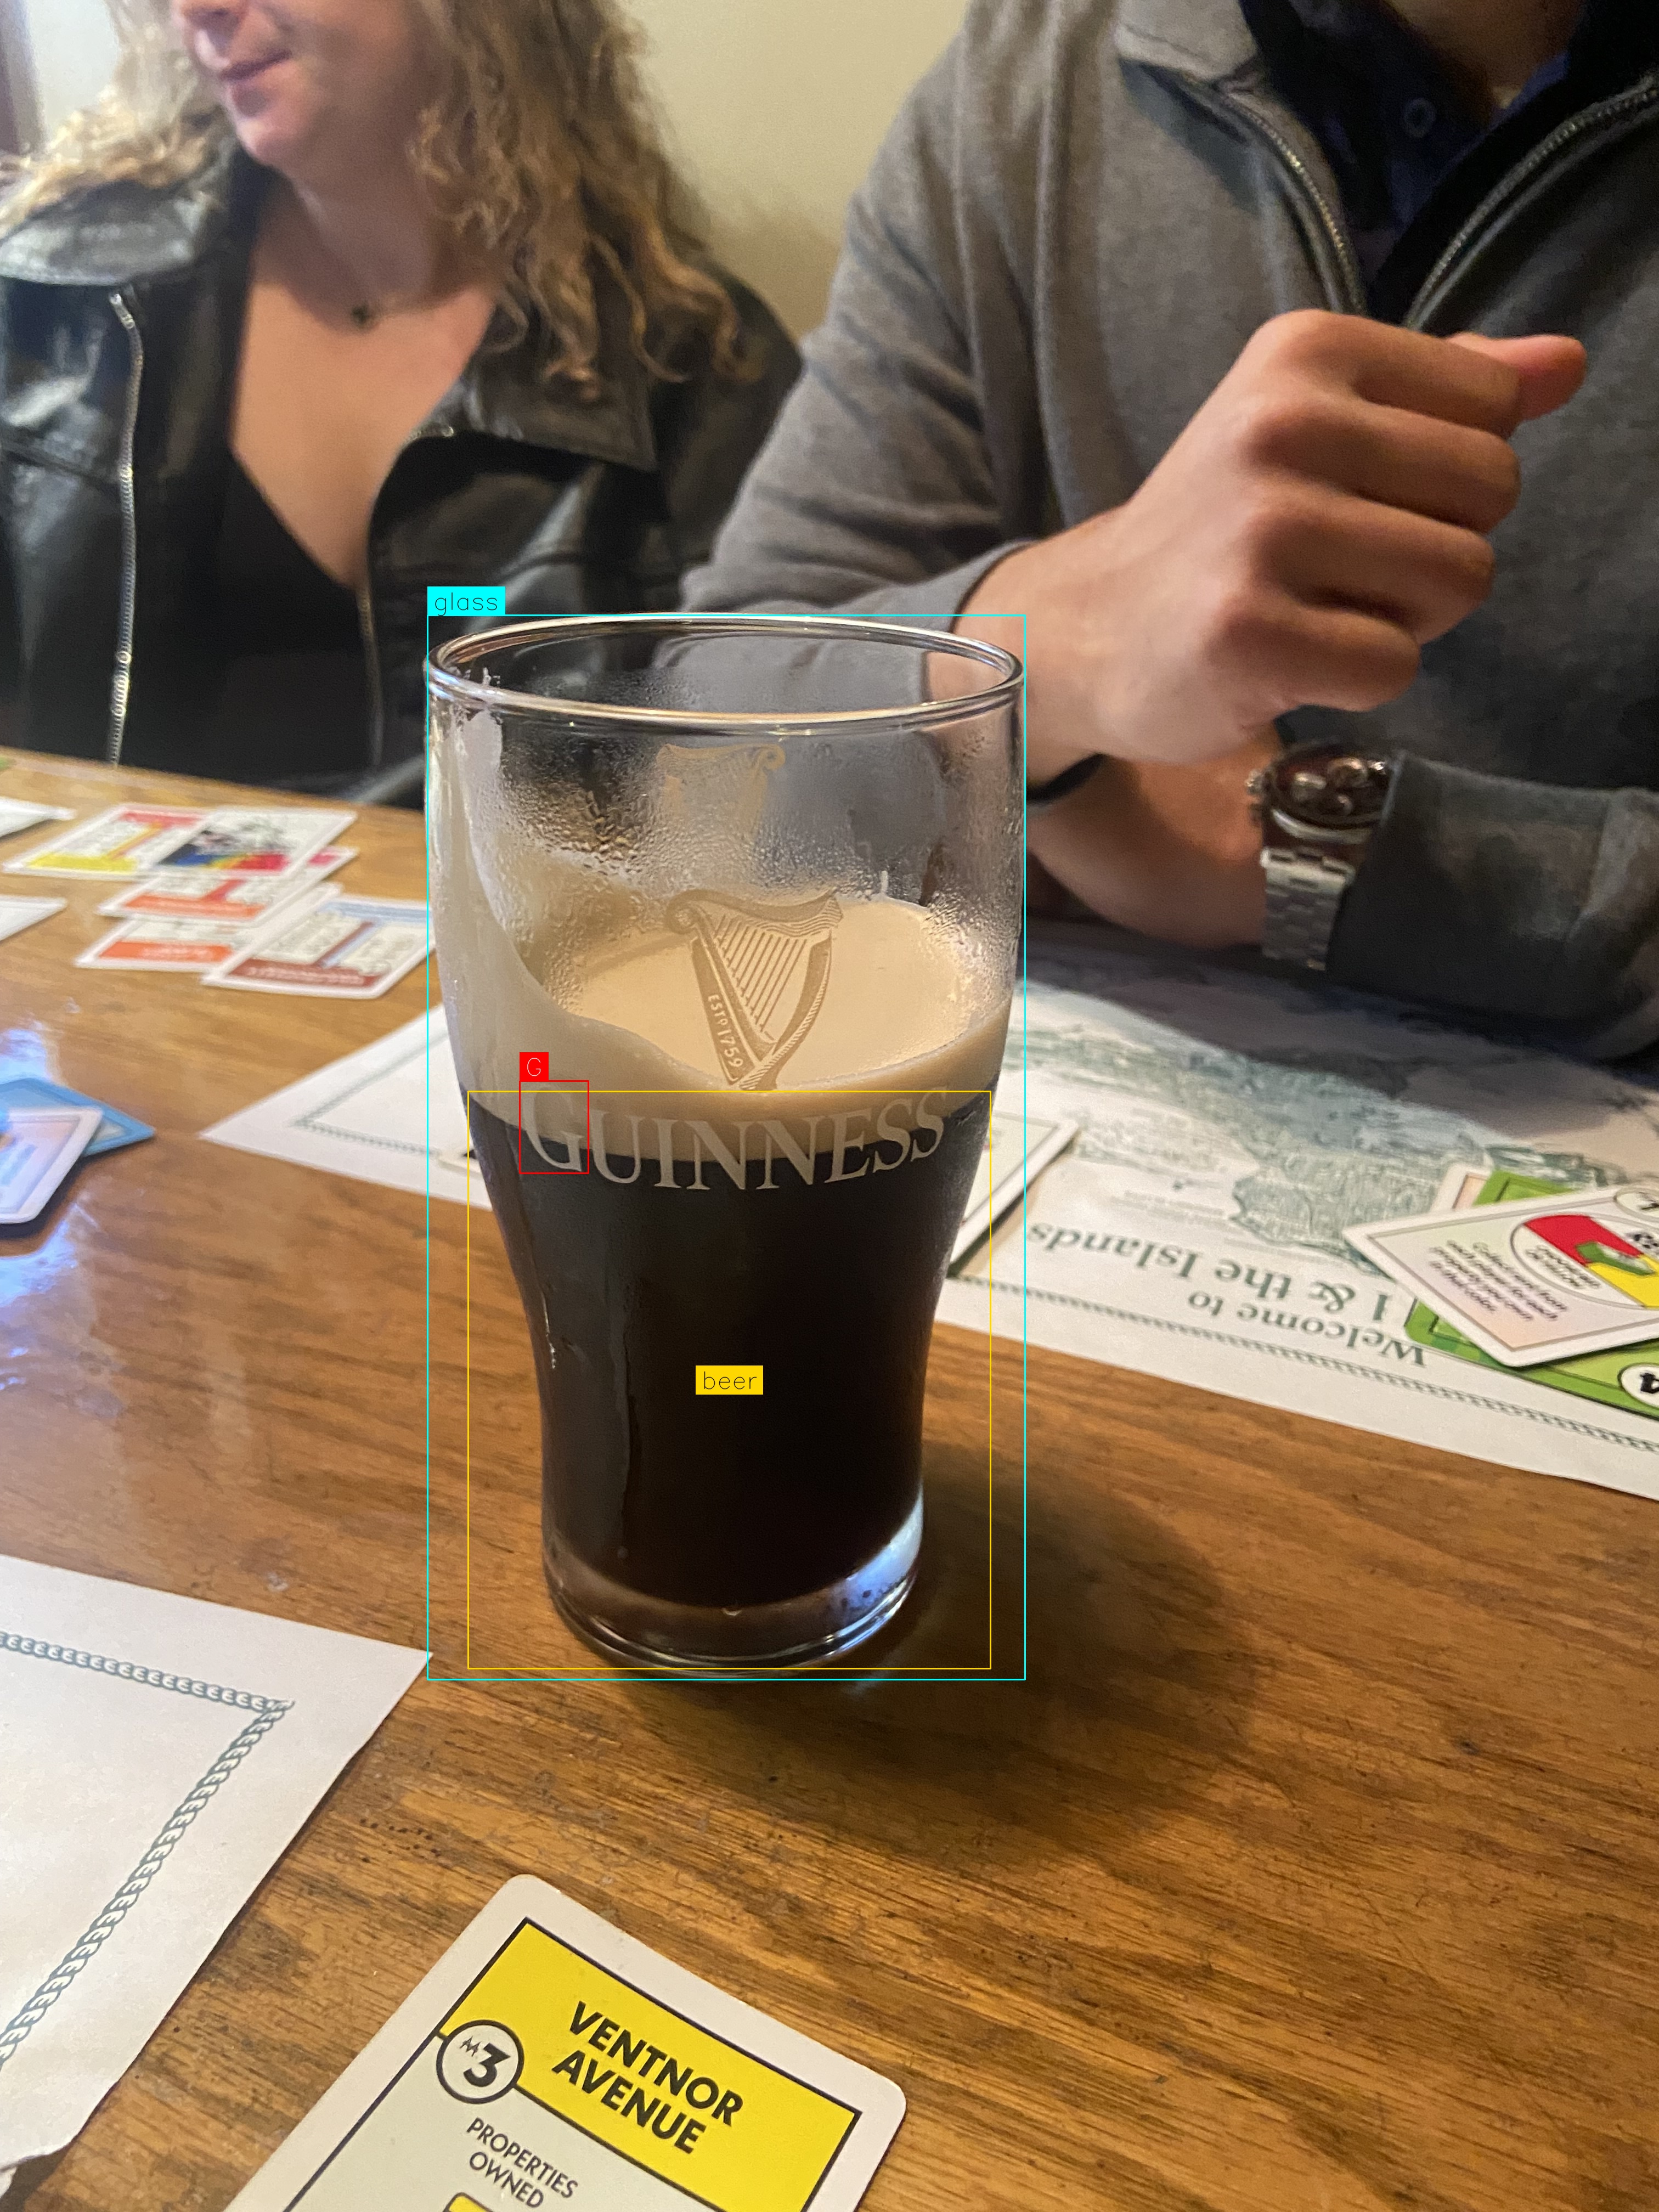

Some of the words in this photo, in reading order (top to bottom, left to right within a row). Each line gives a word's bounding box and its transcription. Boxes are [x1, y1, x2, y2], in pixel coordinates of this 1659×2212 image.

[718, 1029, 743, 1067] 1759
[522, 1084, 948, 1190] GUINNESS
[1028, 1221, 1203, 1279] Islands
[1214, 1257, 1291, 1301] the
[1188, 1290, 1224, 1316] to
[1308, 1280, 1355, 1313] &
[1238, 1301, 1427, 1368] Welcome
[569, 2000, 743, 2127] VENTNOR
[551, 2050, 707, 2154] AVENUE
[466, 2117, 578, 2198] PROPERTIES
[470, 2152, 544, 2208] OWNED
